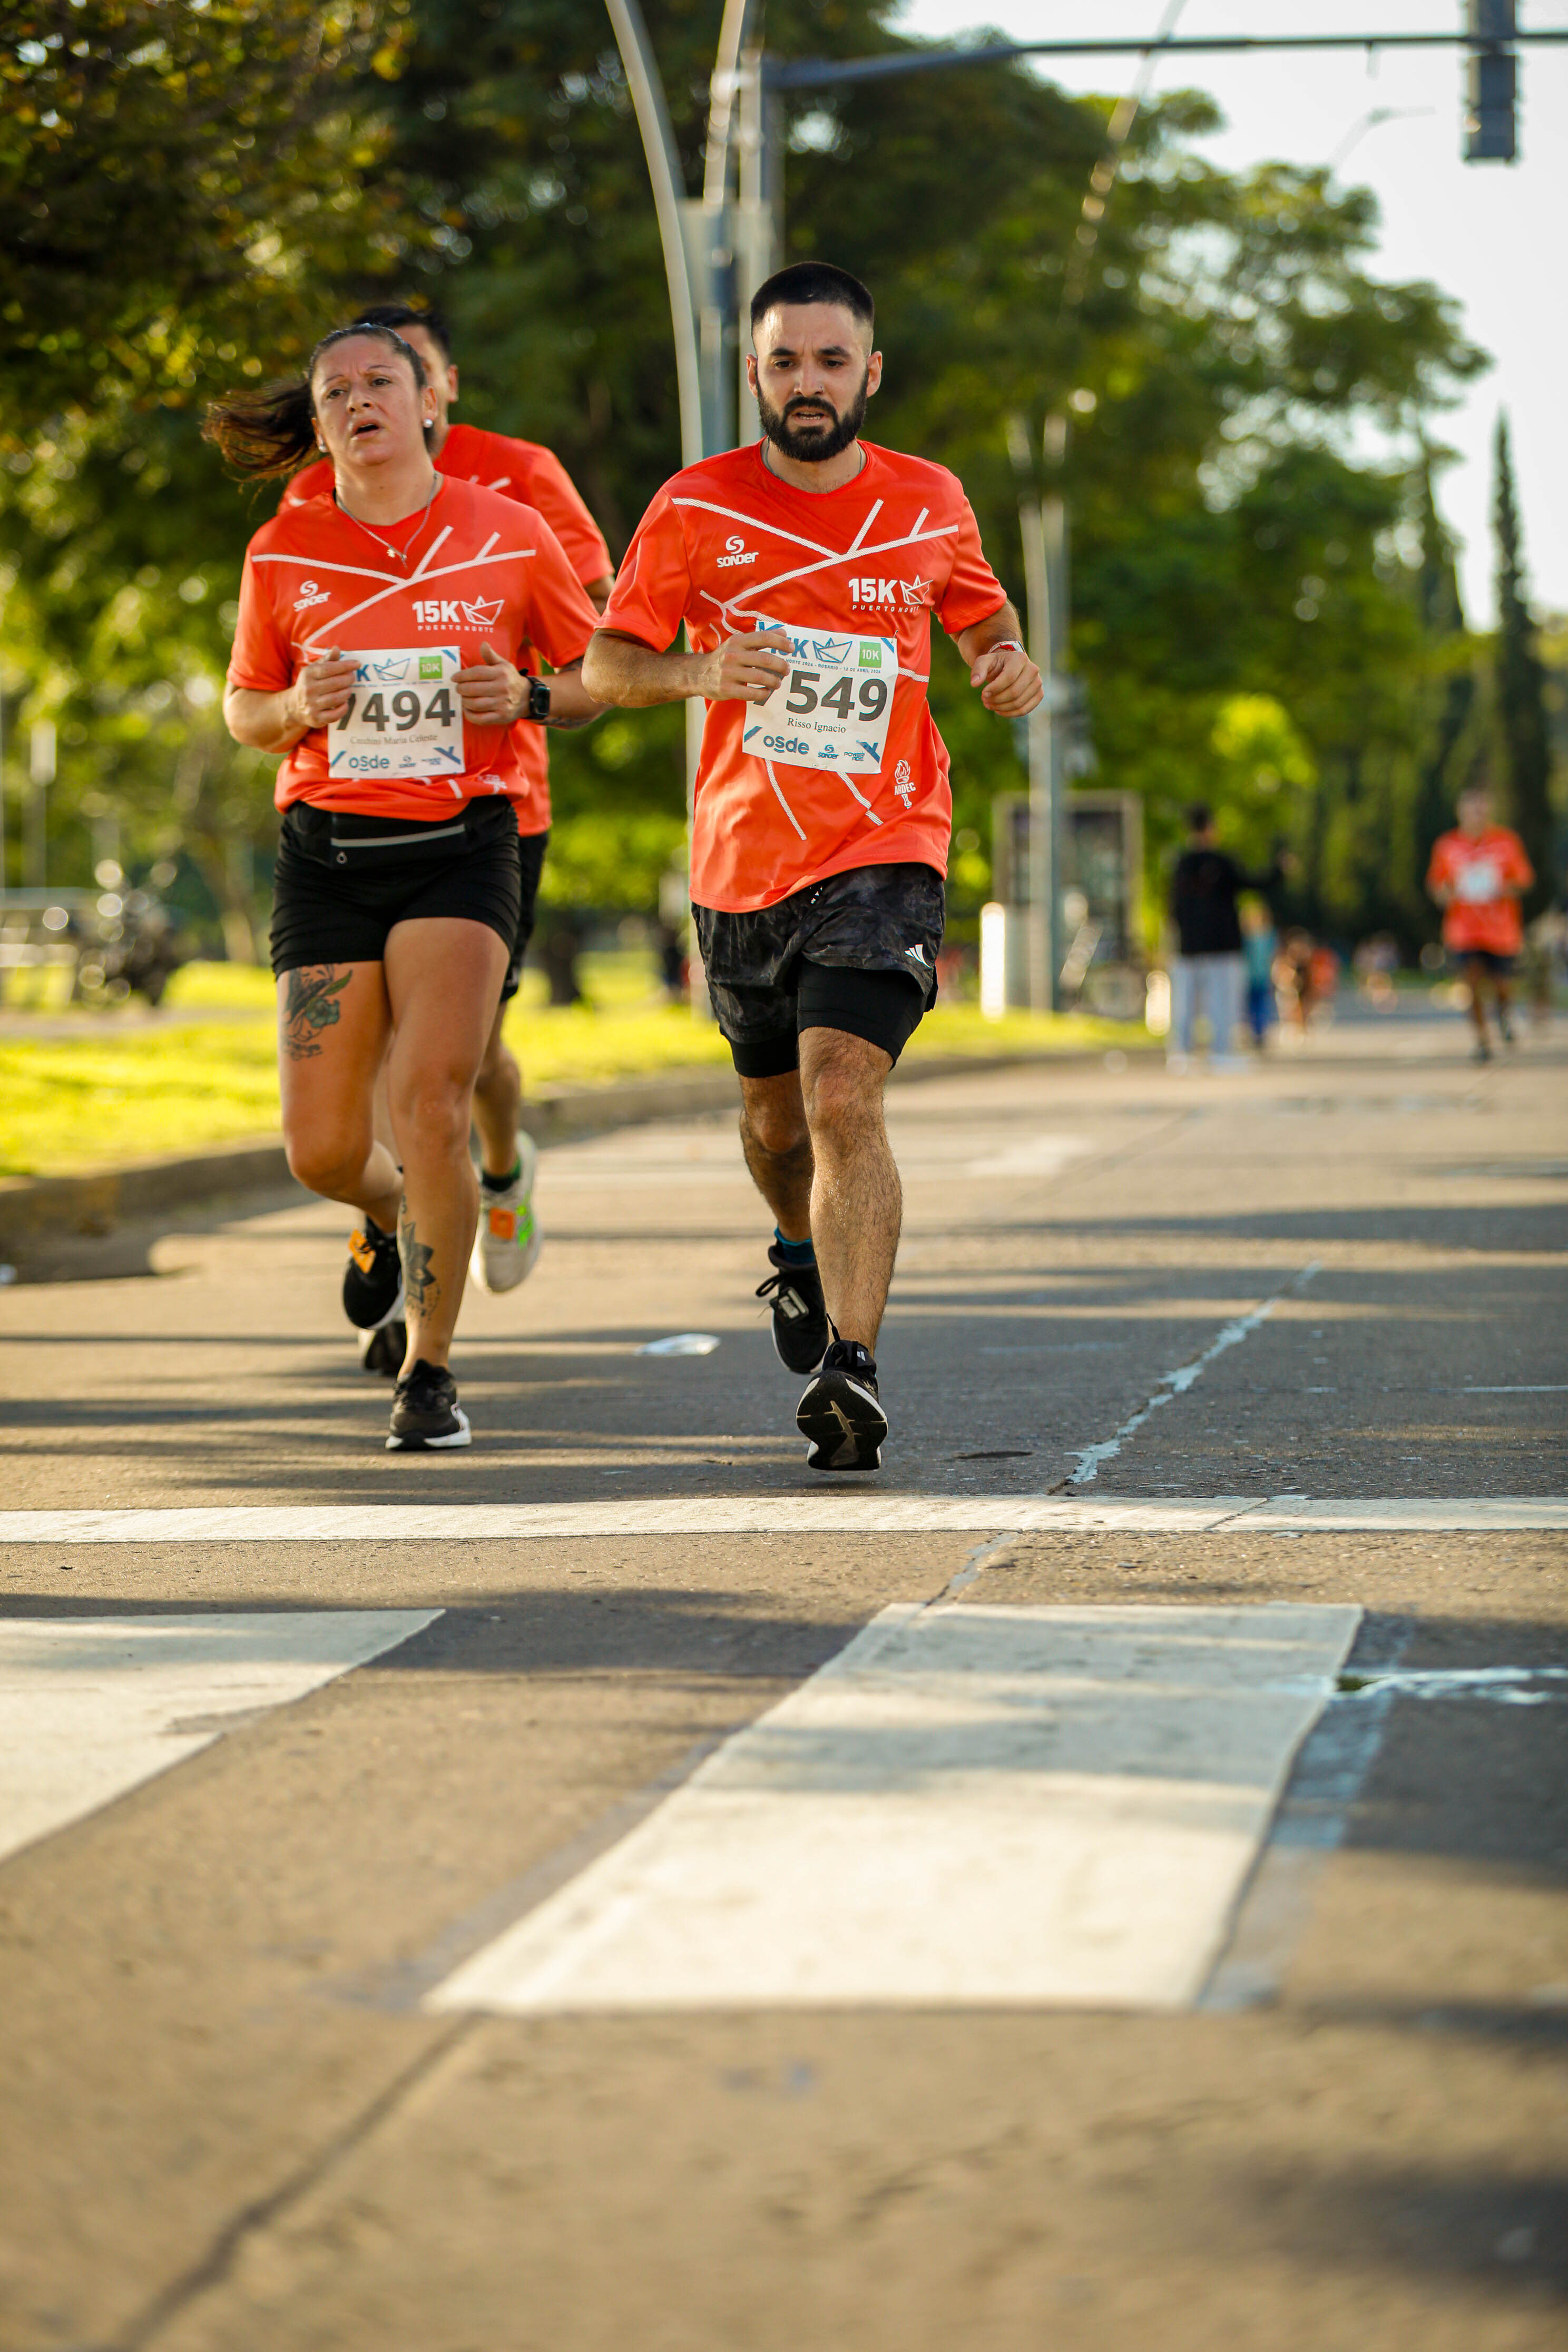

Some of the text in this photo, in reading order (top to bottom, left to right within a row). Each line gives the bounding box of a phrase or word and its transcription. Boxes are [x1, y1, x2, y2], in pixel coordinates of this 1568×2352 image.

[848, 578, 898, 603] 15K
[411, 600, 460, 623] 15K
[861, 649, 879, 661] 10K
[421, 662, 440, 673] 10K
[787, 718, 846, 733] Risso Ignacio
[763, 736, 810, 755] osde
[349, 755, 390, 770] osde
[894, 782, 916, 795] ARDEC
